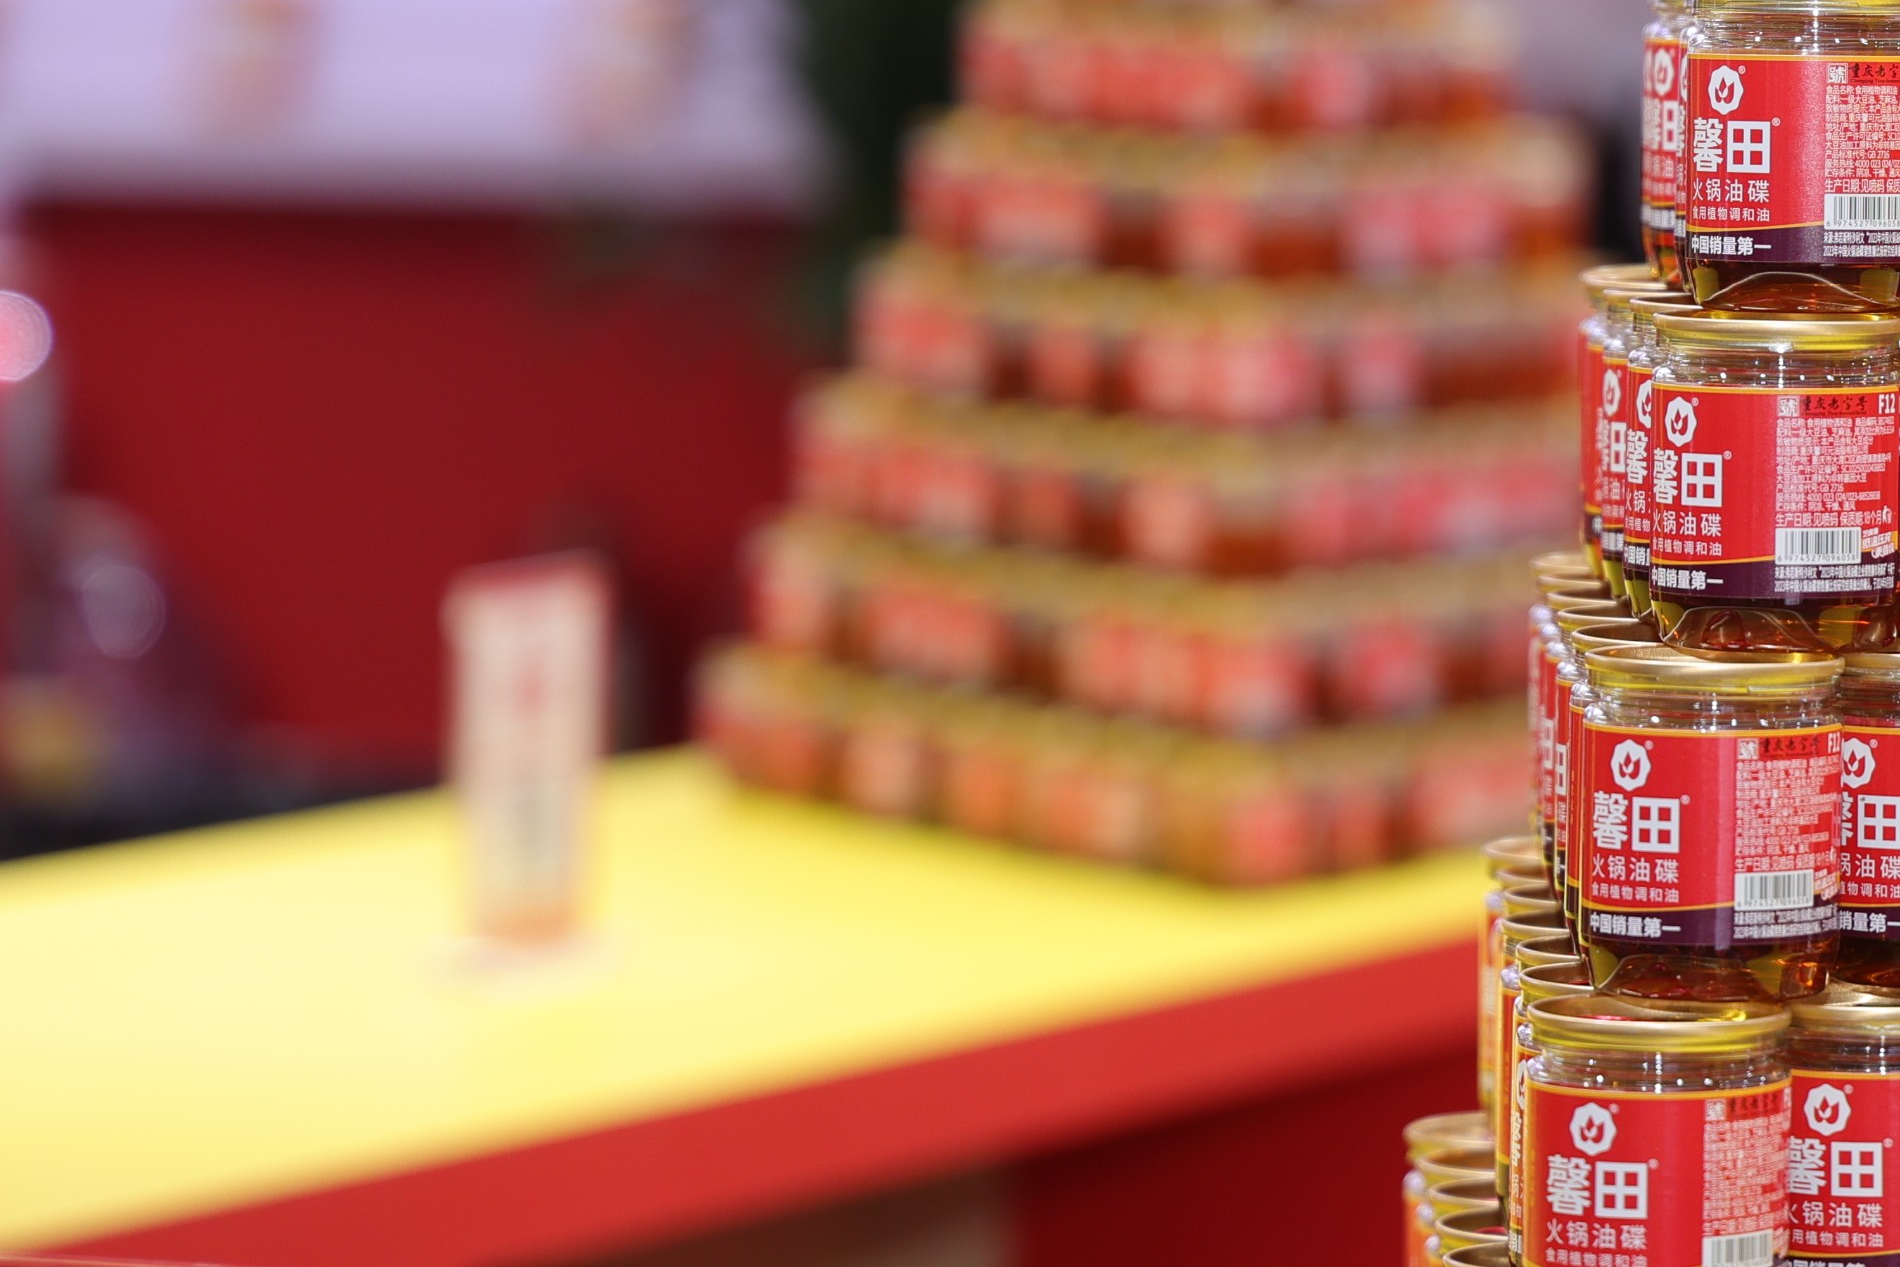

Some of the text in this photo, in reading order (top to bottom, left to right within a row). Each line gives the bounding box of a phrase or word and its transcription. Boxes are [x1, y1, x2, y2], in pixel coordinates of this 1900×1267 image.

[1693, 117, 1770, 173] 馨田
[1692, 179, 1769, 203] 火锅油碟
[1692, 206, 1769, 222] 食用植物调和油
[1692, 235, 1771, 255] 中国销量第一
[1879, 394, 1896, 413] F12
[1653, 447, 1722, 507] 馨田
[1653, 512, 1722, 537] 火锅油碟
[1652, 538, 1722, 556] 食用植物调和油
[1652, 566, 1723, 590] 中国销量第一
[1593, 791, 1679, 853] 馨田
[1592, 856, 1678, 883] 火锅油碟
[1591, 883, 1679, 903] 食用植物调和油
[1590, 912, 1681, 937] 中国销量第一
[1547, 1155, 1647, 1219] 馨田
[1546, 1218, 1647, 1250] 火锅油碟
